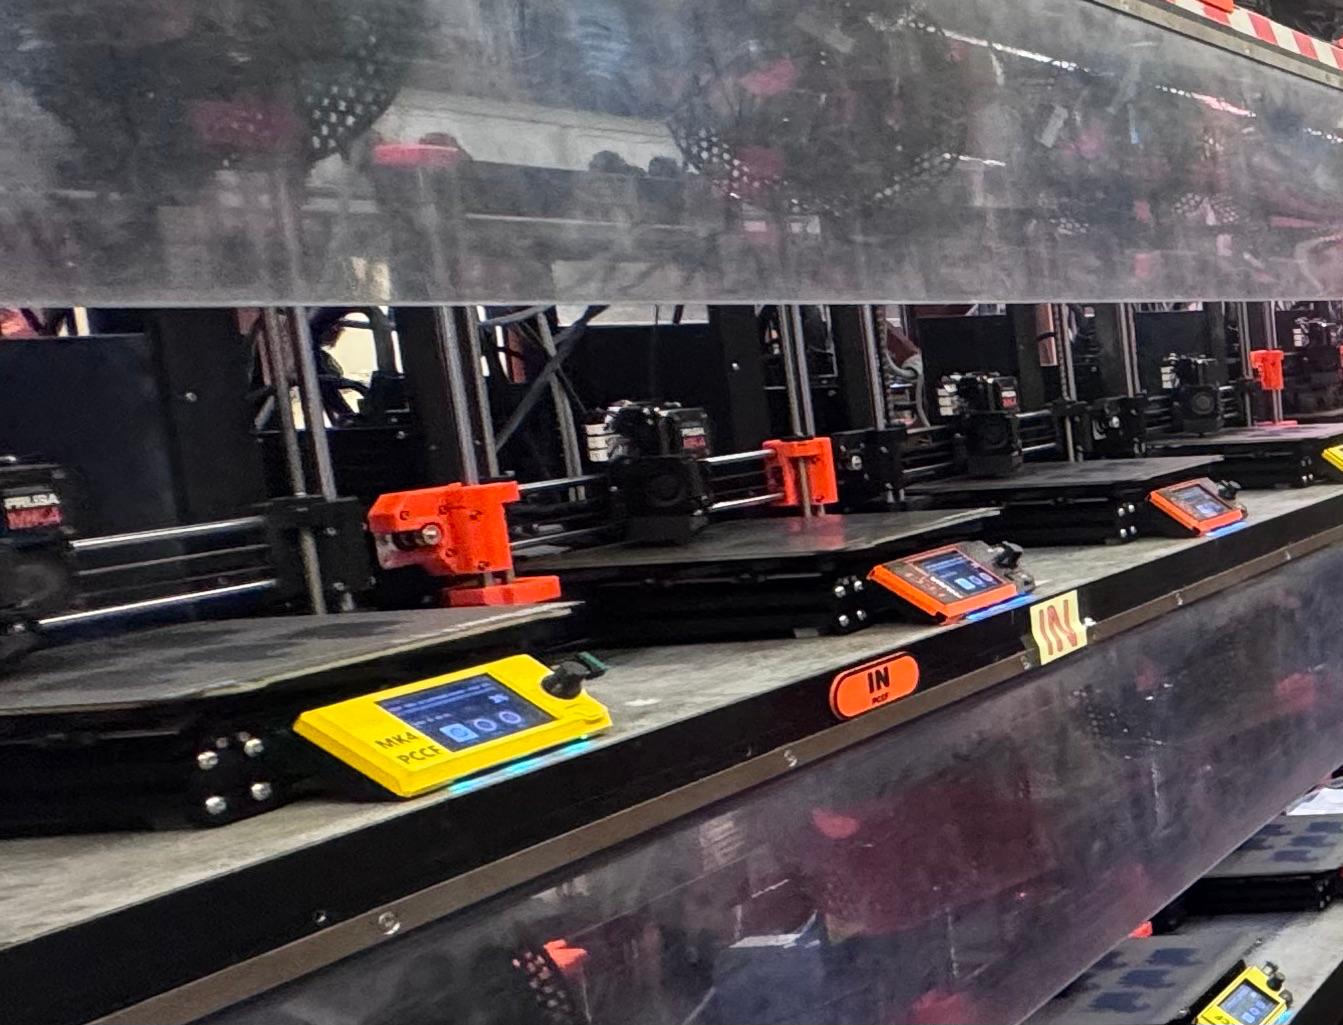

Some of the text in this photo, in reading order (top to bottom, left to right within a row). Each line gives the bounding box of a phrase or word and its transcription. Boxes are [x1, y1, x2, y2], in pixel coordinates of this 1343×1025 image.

[1038, 599, 1078, 656] IN
[867, 666, 890, 694] IN
[375, 731, 419, 750] MK4
[398, 745, 441, 765] PCCF
